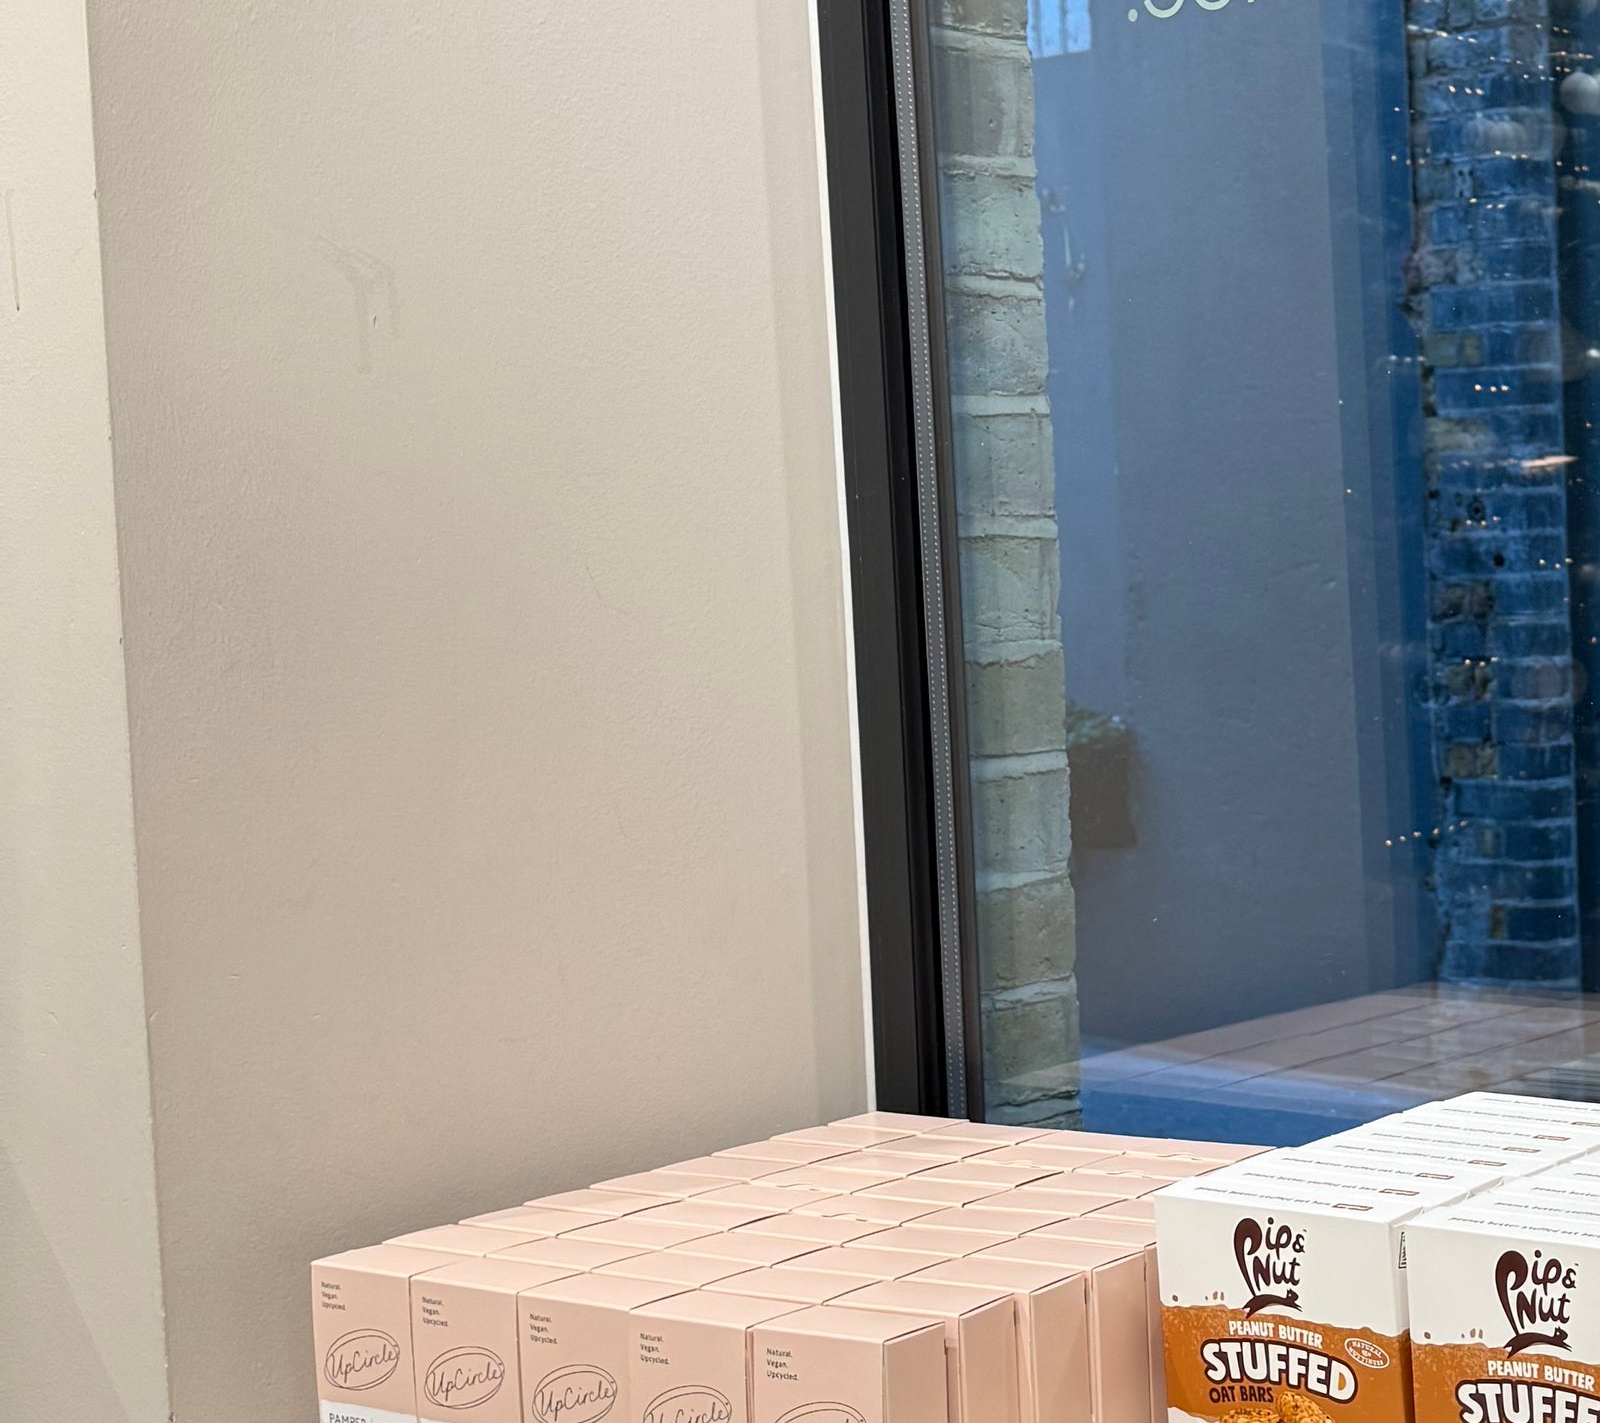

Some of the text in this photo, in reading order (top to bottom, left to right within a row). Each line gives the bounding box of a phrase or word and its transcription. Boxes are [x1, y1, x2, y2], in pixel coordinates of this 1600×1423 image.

[1251, 1255, 1301, 1292] Nut
[1516, 1288, 1571, 1329] Nut
[1228, 1320, 1323, 1349] PEANUT BUTTER
[330, 1343, 395, 1383] UpCircle
[431, 1362, 500, 1401] UpCircle
[1201, 1340, 1357, 1403] STUFFED
[1487, 1360, 1595, 1391] PEANUT BUTTER
[540, 1380, 611, 1421] UpCircle
[1209, 1386, 1274, 1404] OAT BARS
